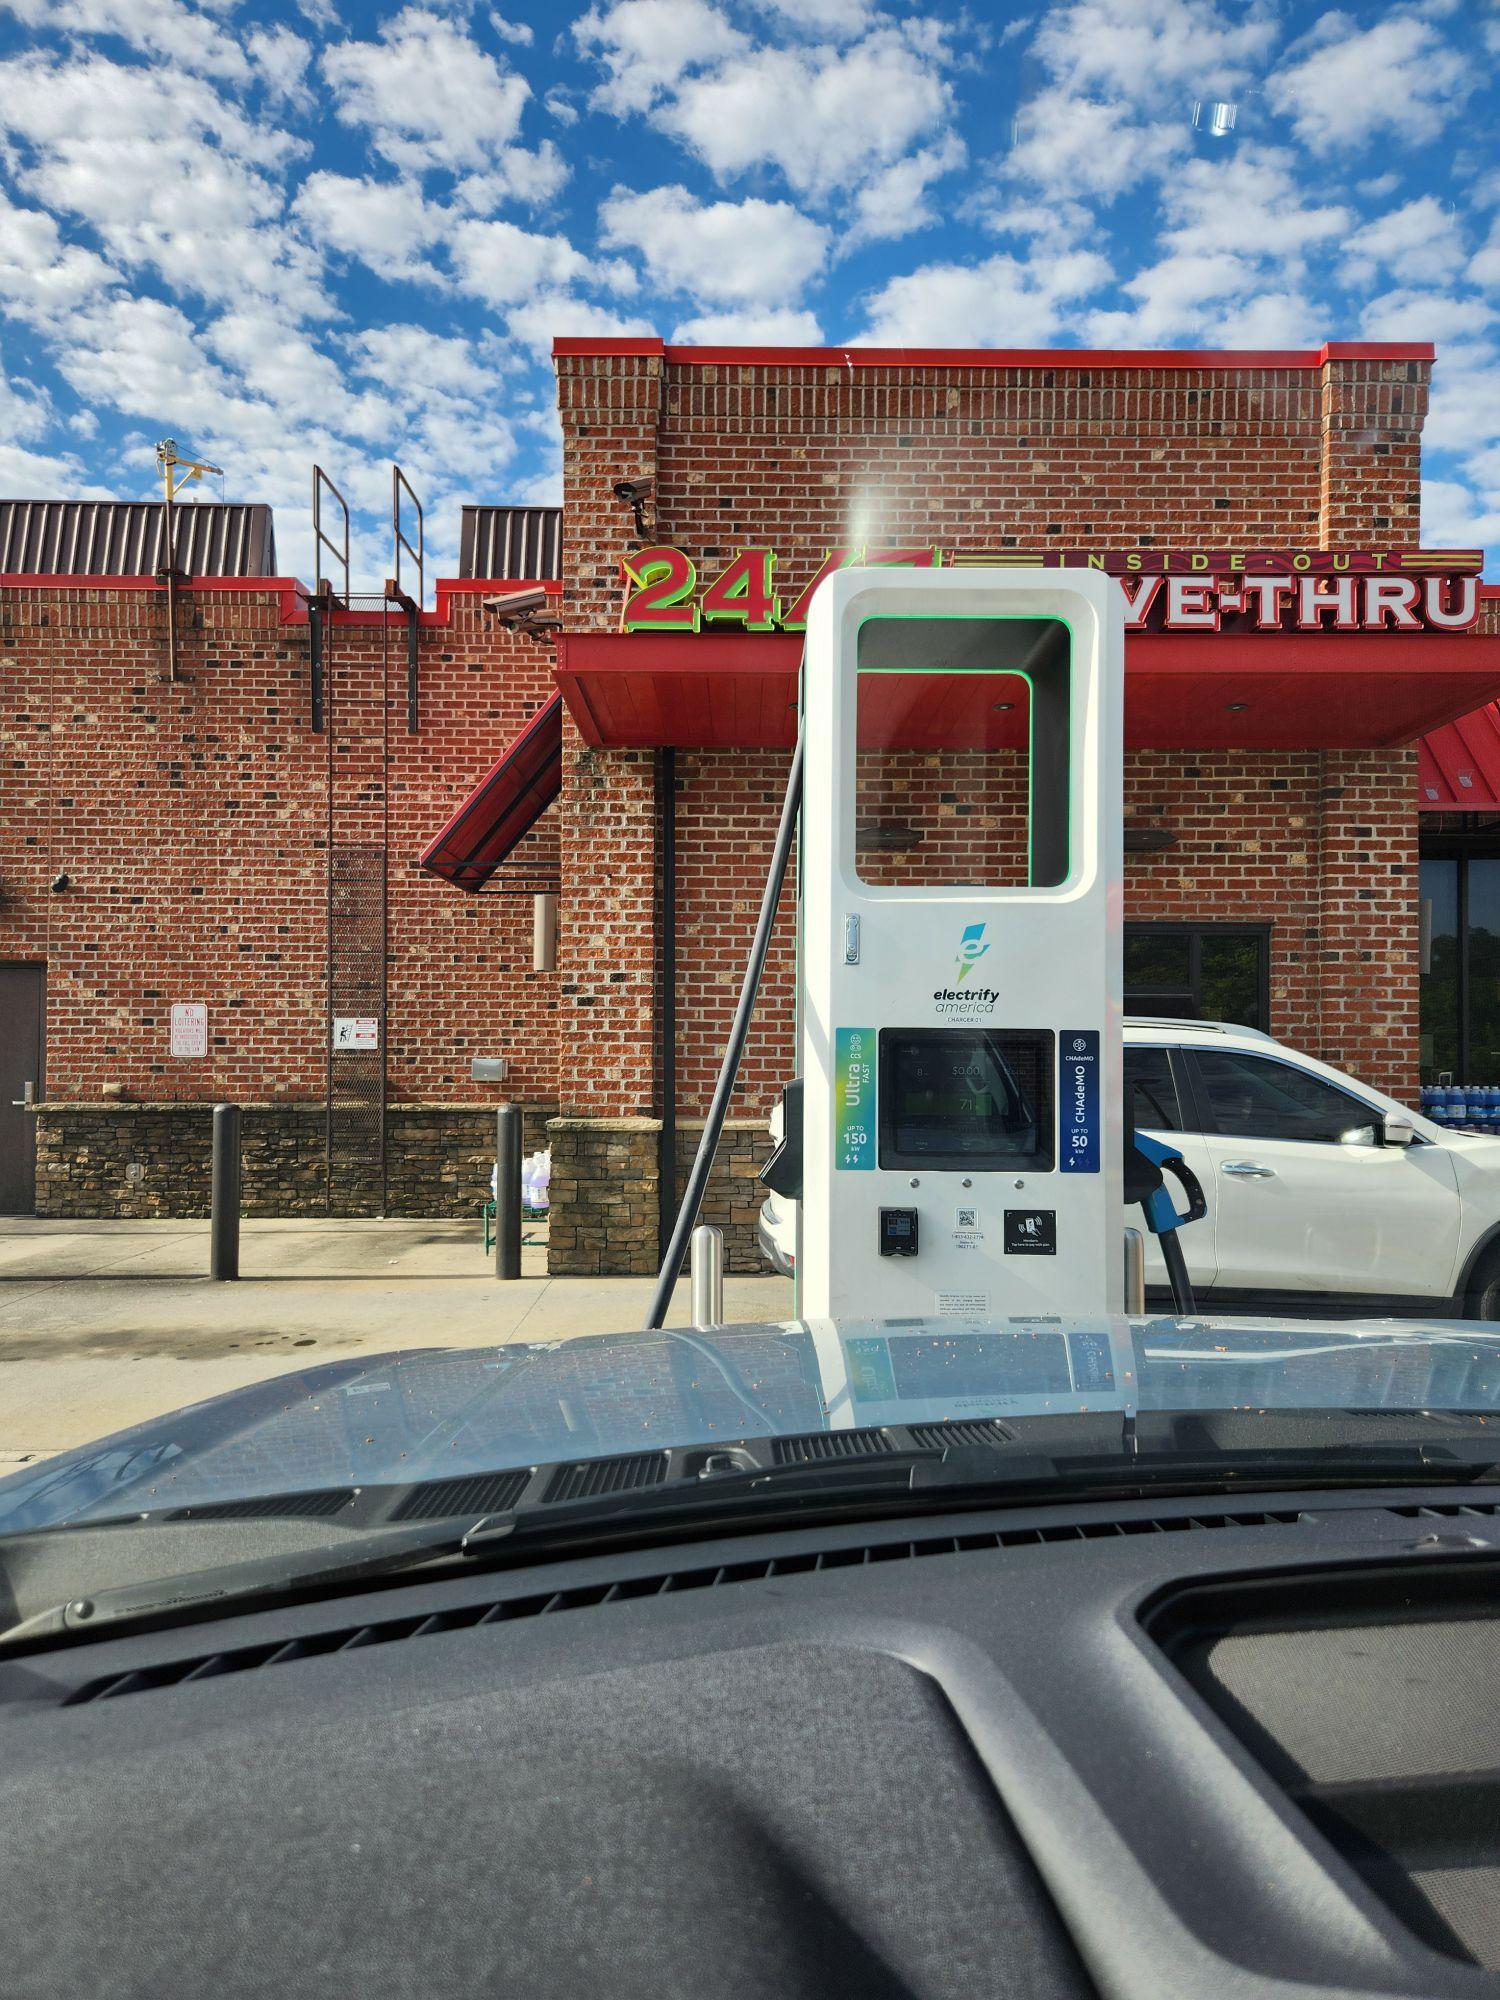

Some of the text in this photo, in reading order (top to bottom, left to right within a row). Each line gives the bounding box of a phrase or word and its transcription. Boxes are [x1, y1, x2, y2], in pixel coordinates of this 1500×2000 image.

[622, 545, 1481, 633] 24/ VE-THRU
[933, 988, 1000, 1003] electrify
[184, 1008, 194, 1017] NO
[935, 1002, 994, 1013] america
[174, 1017, 205, 1026] LOITERING
[862, 1063, 870, 1084] FAST
[844, 1063, 860, 1106] Ultra
[1074, 1065, 1086, 1123] CHAdeMO
[844, 1132, 867, 1145] 150
[1071, 1135, 1088, 1147] 50
